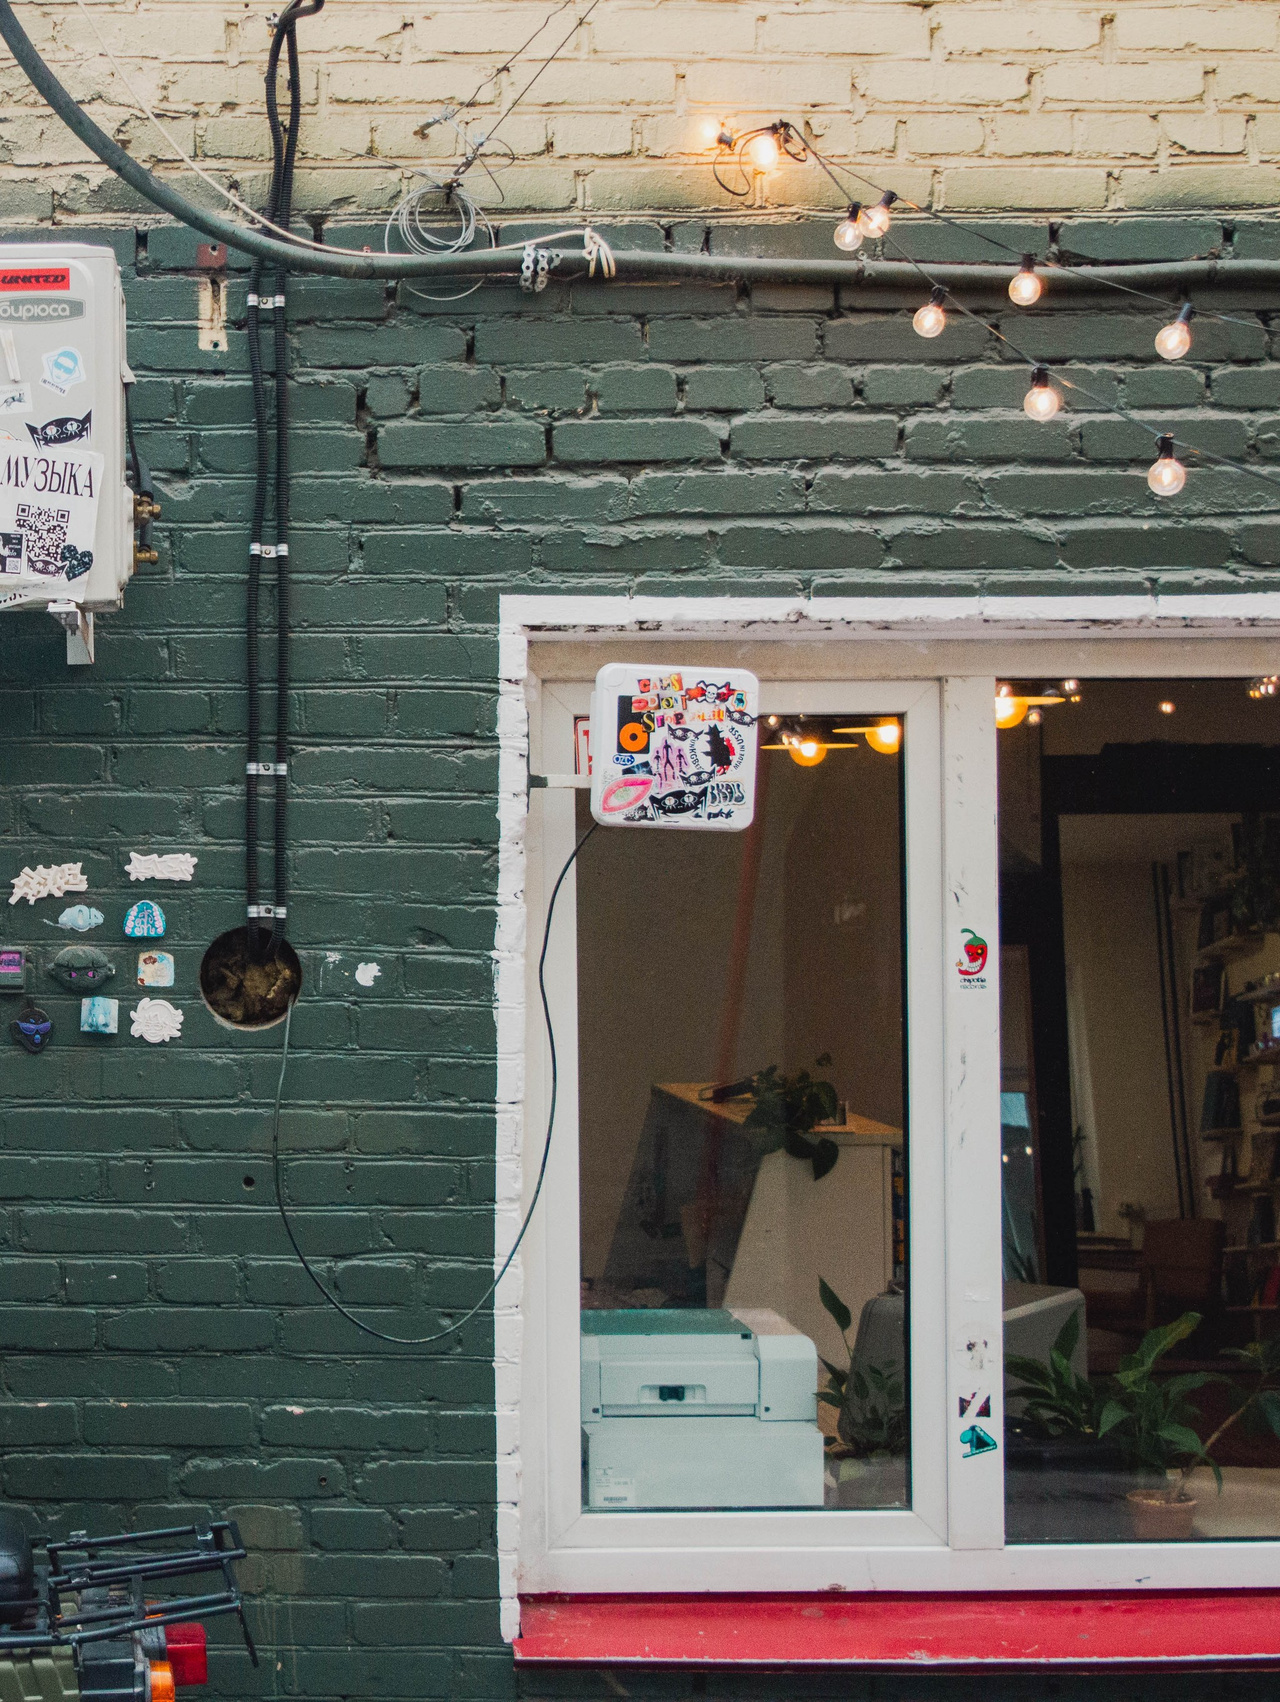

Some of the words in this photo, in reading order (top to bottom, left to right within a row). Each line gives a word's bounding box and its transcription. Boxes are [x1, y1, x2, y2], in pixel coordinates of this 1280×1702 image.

[0, 274, 67, 284] UNITED
[0, 301, 71, 320] бирюса
[0, 454, 94, 498] МУЗЫКА
[728, 725, 744, 745] USSR
[733, 753, 745, 770] MADE
